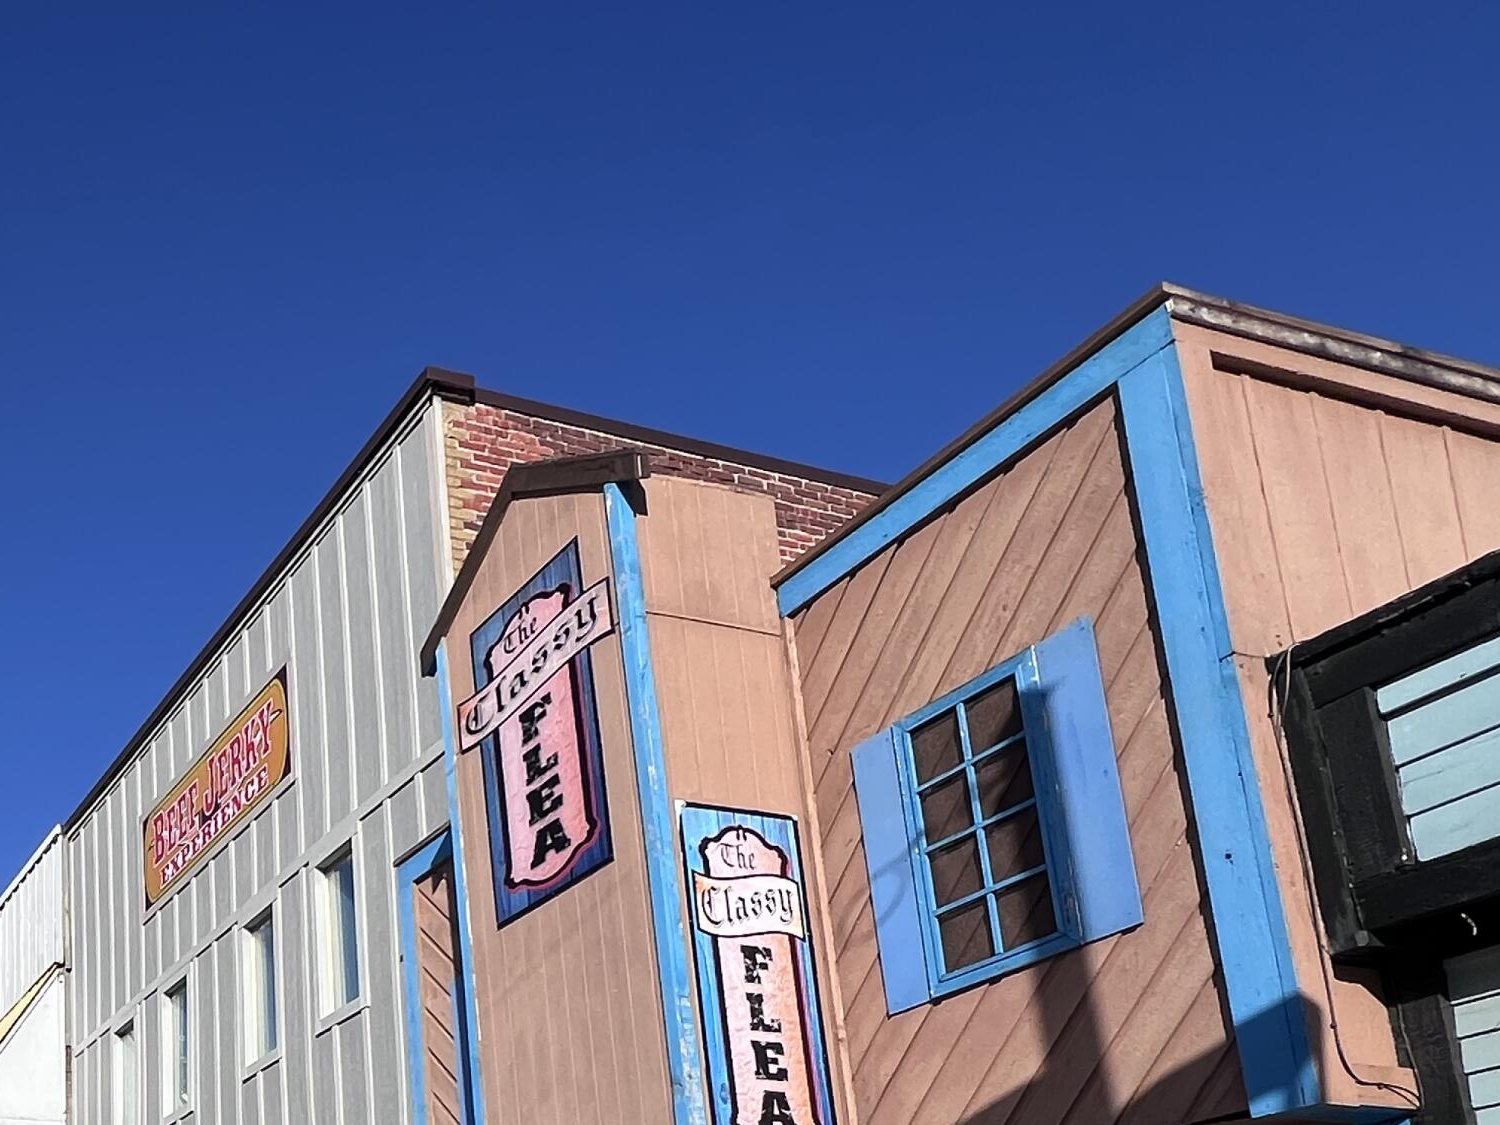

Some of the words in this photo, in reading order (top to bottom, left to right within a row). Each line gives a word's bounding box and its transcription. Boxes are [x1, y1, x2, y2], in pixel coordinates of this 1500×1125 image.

[466, 594, 597, 735] Classy
[503, 617, 537, 654] The
[153, 779, 199, 866] BEEF
[202, 697, 273, 817] JERKY
[159, 763, 269, 889] EXPERIENCE
[518, 691, 572, 871] FLEA
[701, 885, 794, 927] Classy
[713, 842, 756, 870] The
